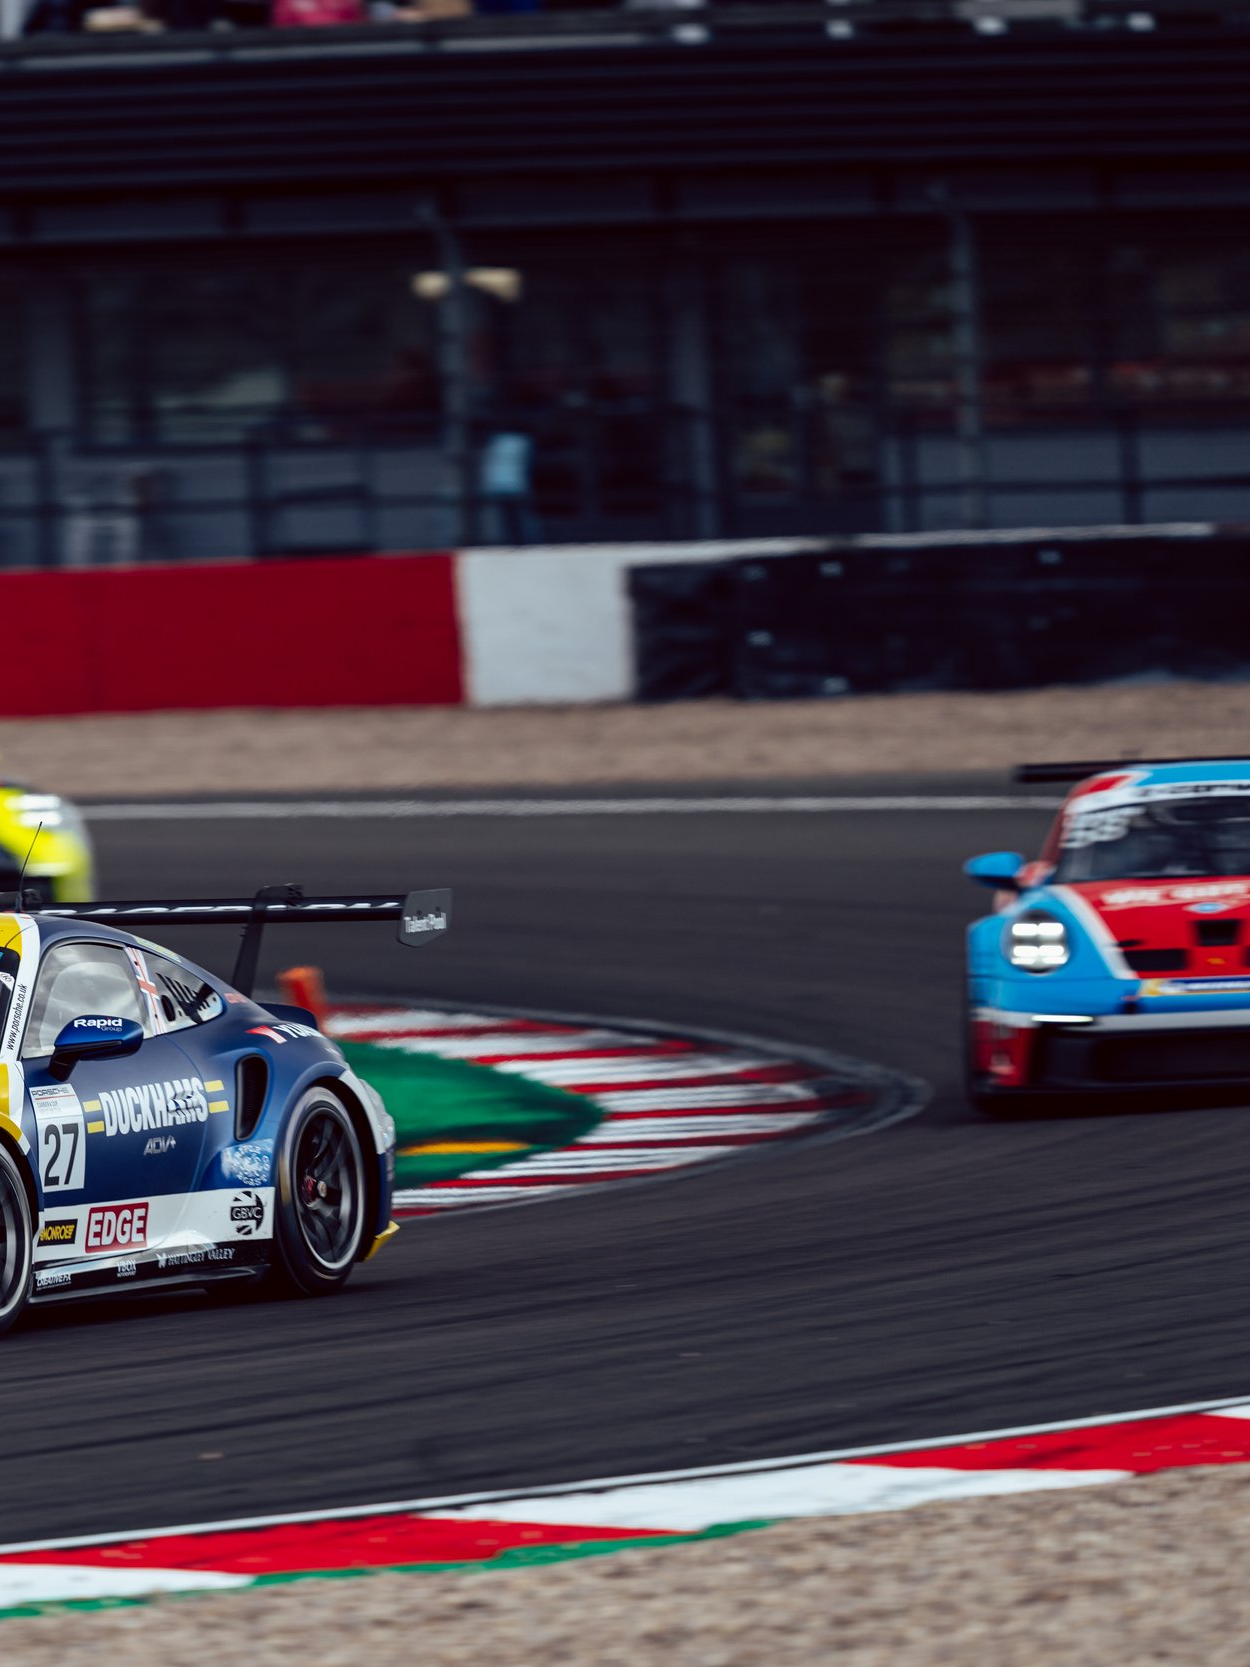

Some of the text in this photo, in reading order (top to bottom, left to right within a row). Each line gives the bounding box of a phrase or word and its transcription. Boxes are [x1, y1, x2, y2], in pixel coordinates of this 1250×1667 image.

[7, 983, 27, 1051] www.porsche.co.uk
[74, 1017, 123, 1028] Rapid
[31, 1087, 69, 1096] PORSCHE
[98, 1077, 209, 1137] DUCKHAMS
[44, 1123, 79, 1187] 27
[41, 1225, 75, 1241] MONROE
[88, 1207, 146, 1247] EDGE
